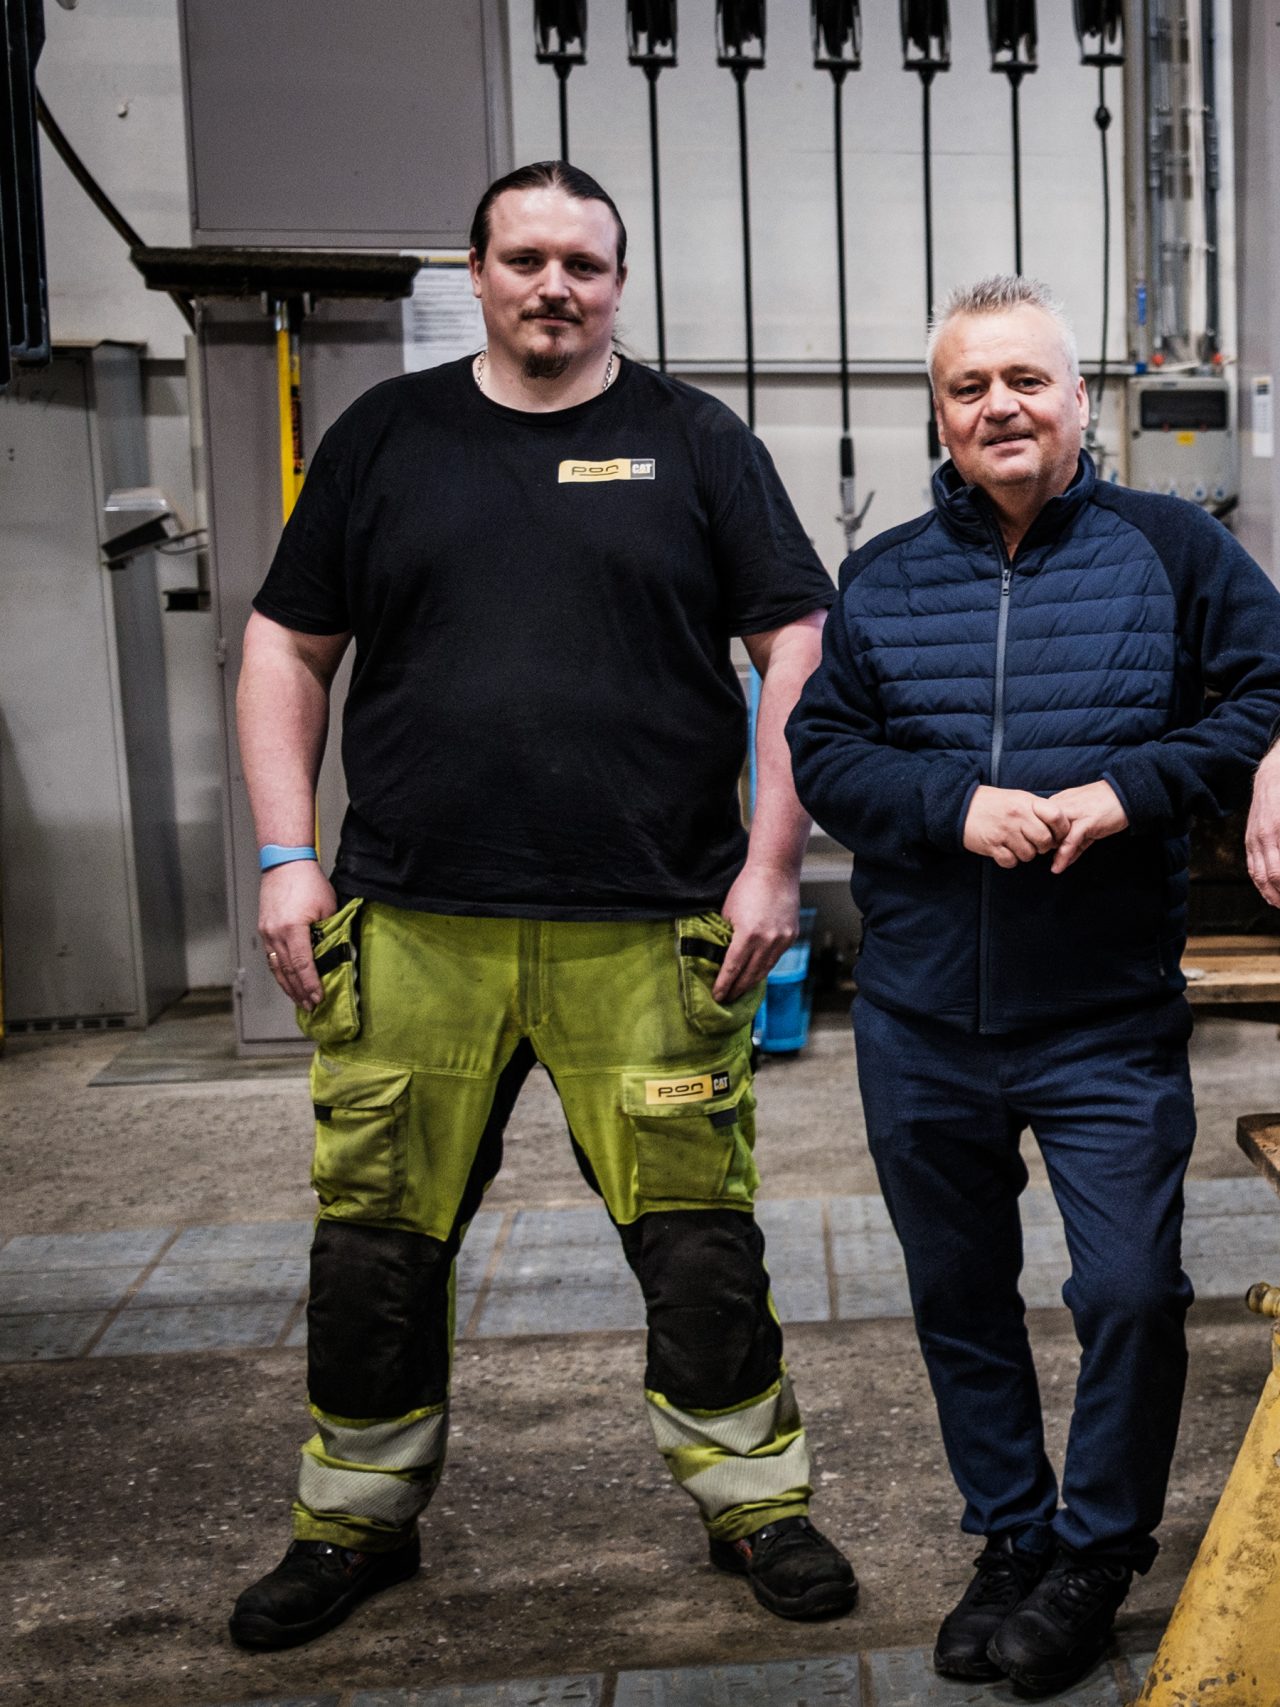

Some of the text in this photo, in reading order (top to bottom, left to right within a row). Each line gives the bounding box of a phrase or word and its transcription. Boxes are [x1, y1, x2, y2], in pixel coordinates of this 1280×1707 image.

[571, 463, 652, 476] pon CAT
[658, 1076, 728, 1098] pon CAT
